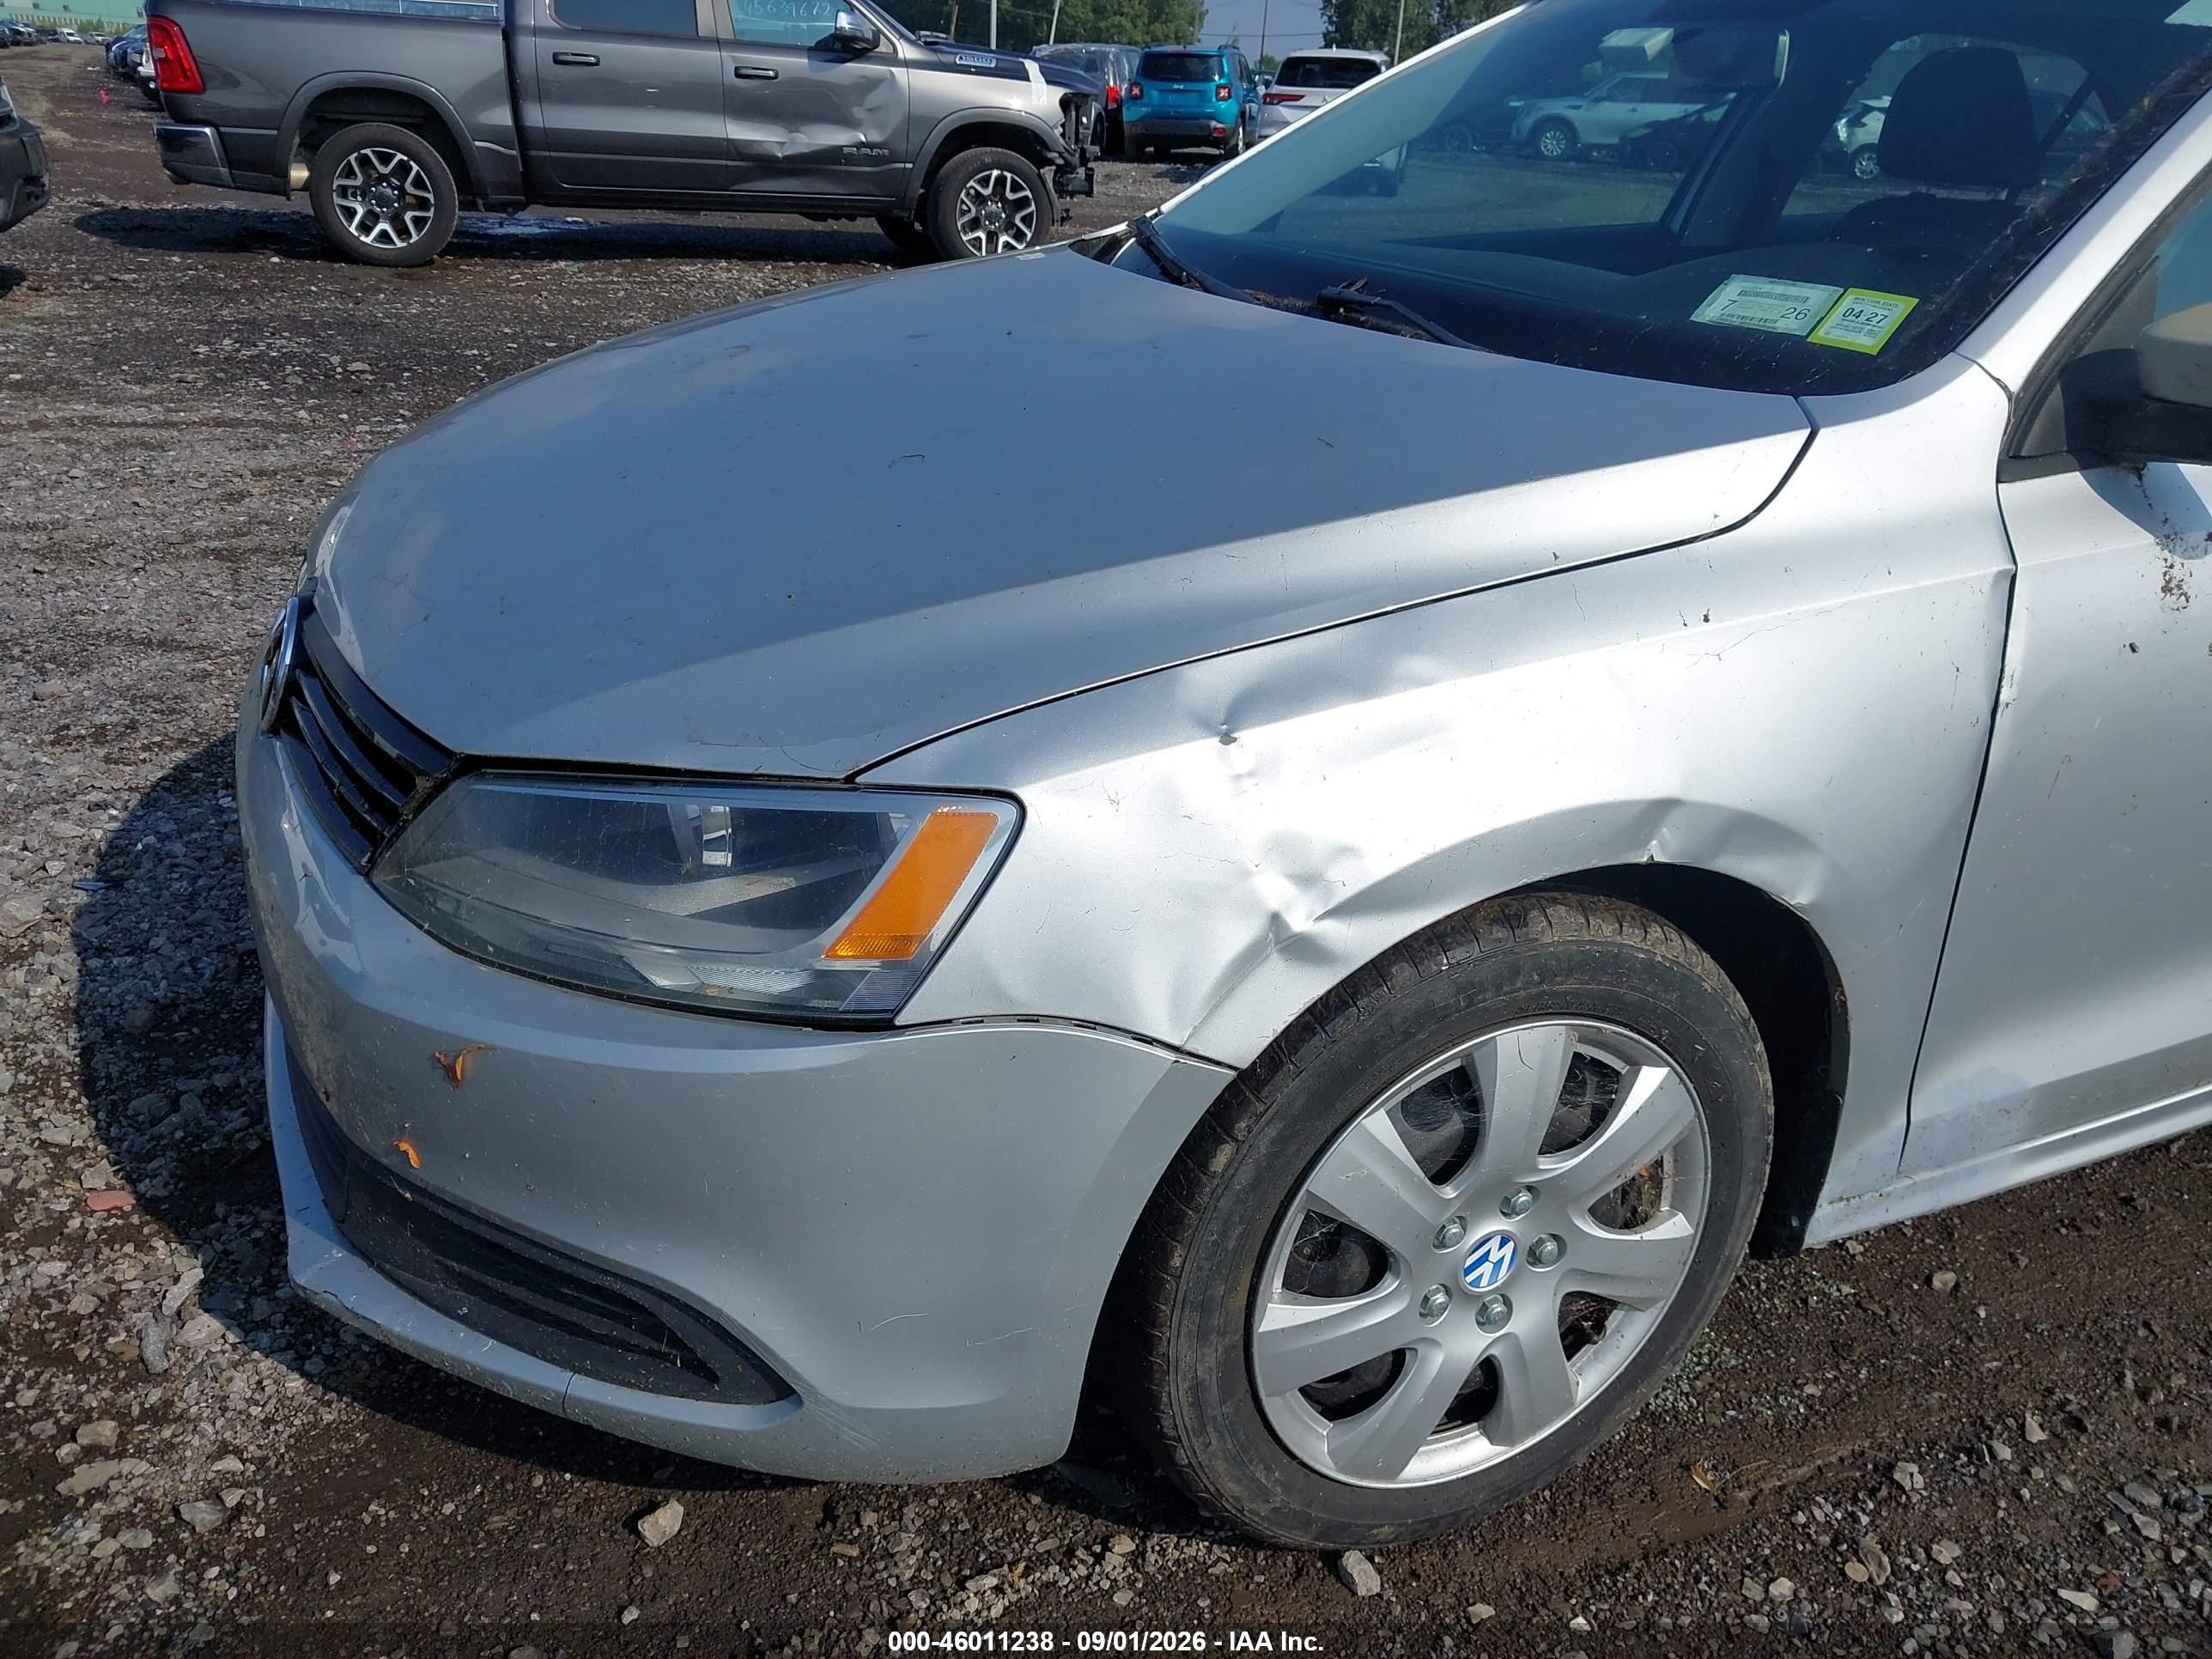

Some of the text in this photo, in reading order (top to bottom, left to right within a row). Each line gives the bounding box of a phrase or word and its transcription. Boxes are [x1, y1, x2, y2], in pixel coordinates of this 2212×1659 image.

[842, 147, 890, 156] RAM
[1720, 299, 1738, 311] 7
[1779, 307, 1811, 321] 26
